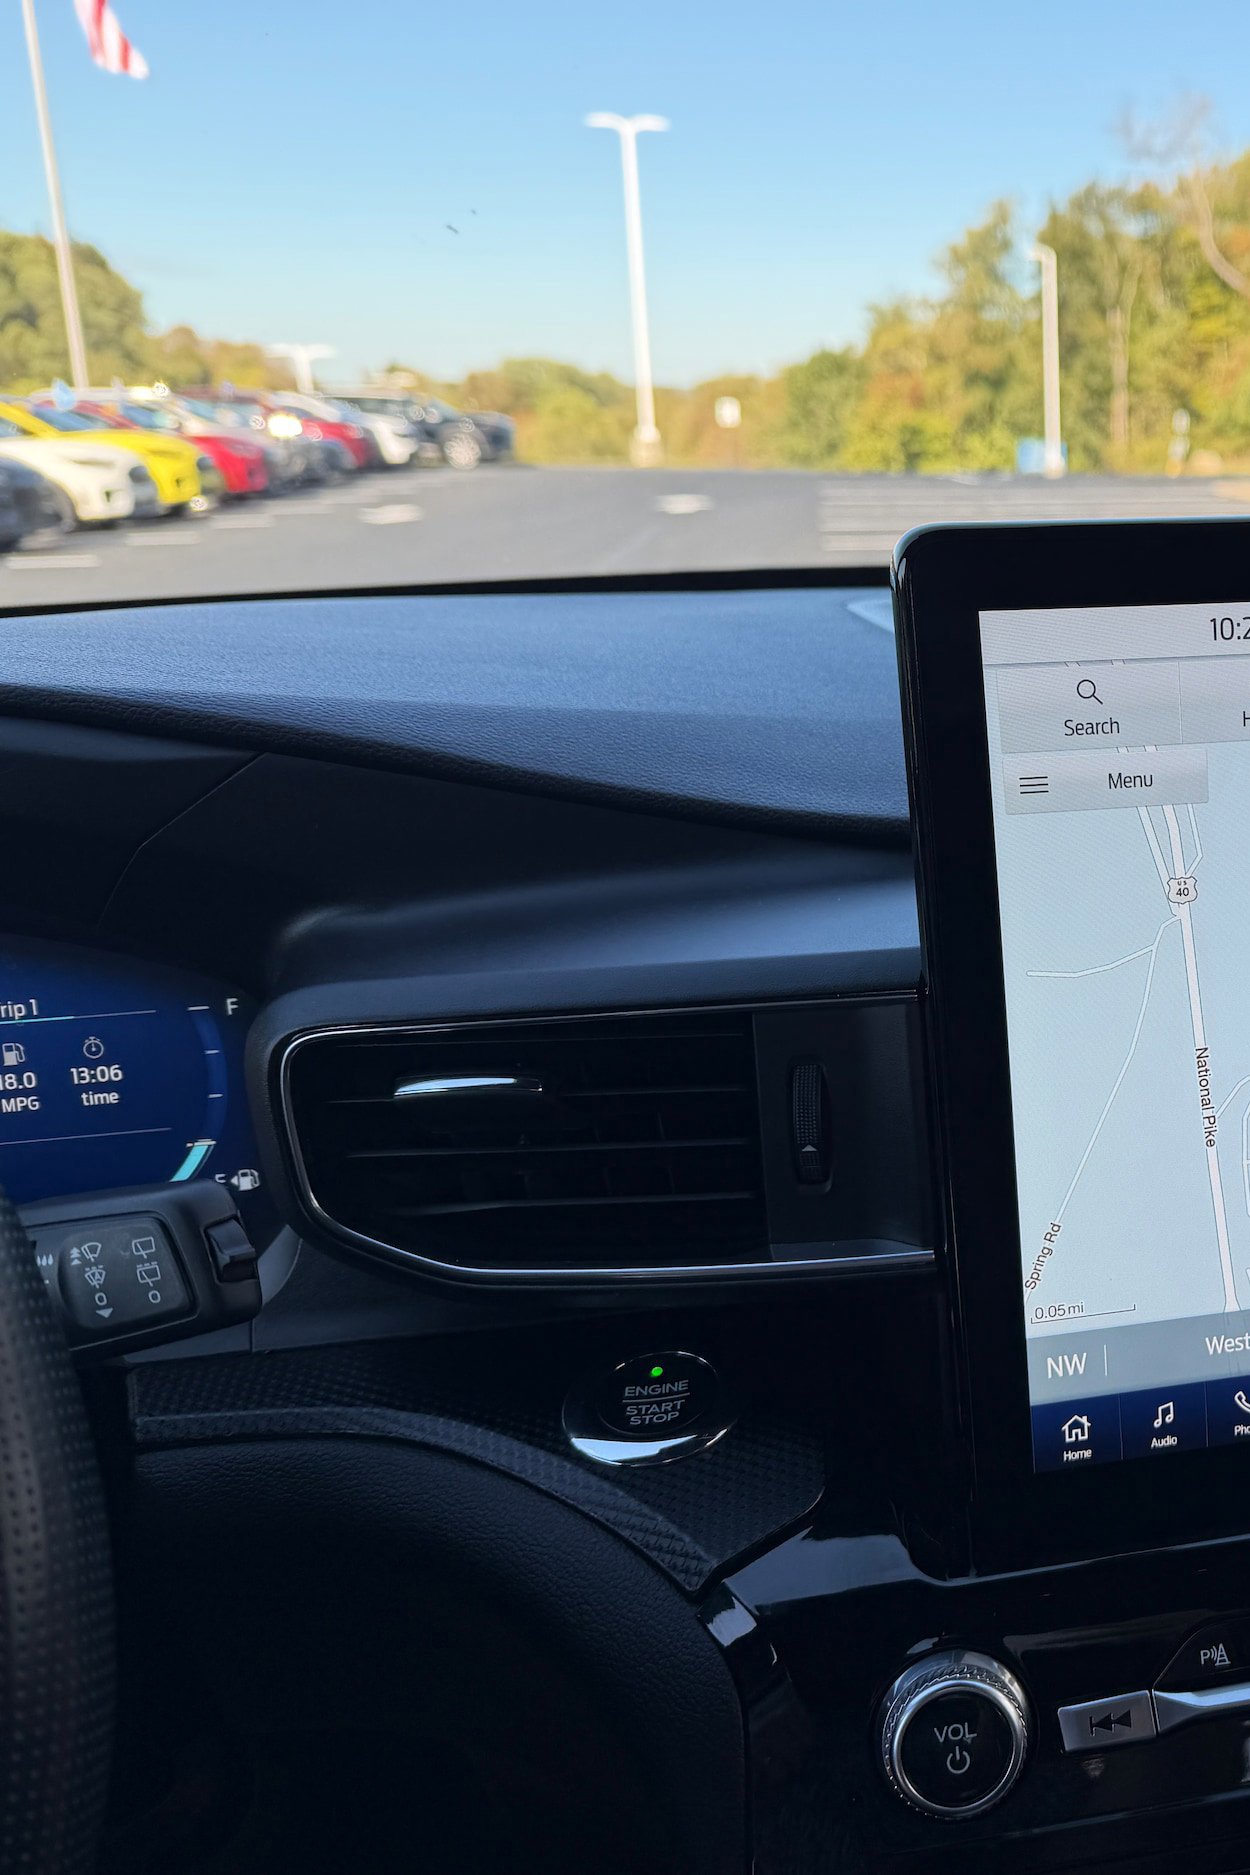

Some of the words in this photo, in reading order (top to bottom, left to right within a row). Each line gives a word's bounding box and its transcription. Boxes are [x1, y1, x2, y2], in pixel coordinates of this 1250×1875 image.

[1063, 717, 1120, 738] Search
[1107, 770, 1154, 791] Menu
[1175, 887, 1190, 898] 40
[0, 1001, 26, 1020] rip
[226, 998, 239, 1016] F
[70, 1064, 123, 1085] 13:06
[1195, 1047, 1215, 1112] National
[1, 1096, 40, 1113] MPG
[81, 1091, 120, 1106] time
[1203, 1115, 1217, 1149] Pike
[1025, 1245, 1053, 1290] Spring
[1043, 1222, 1062, 1243] Rd
[1034, 1304, 1067, 1320] 0.05
[1068, 1302, 1085, 1315] mi
[1046, 1352, 1087, 1379] NW
[624, 1380, 689, 1397] ENGINE
[626, 1400, 685, 1415] START
[629, 1411, 680, 1426] STOP
[1150, 1434, 1178, 1448] Audio
[1063, 1448, 1092, 1462] Home
[934, 1722, 978, 1744] VOL
